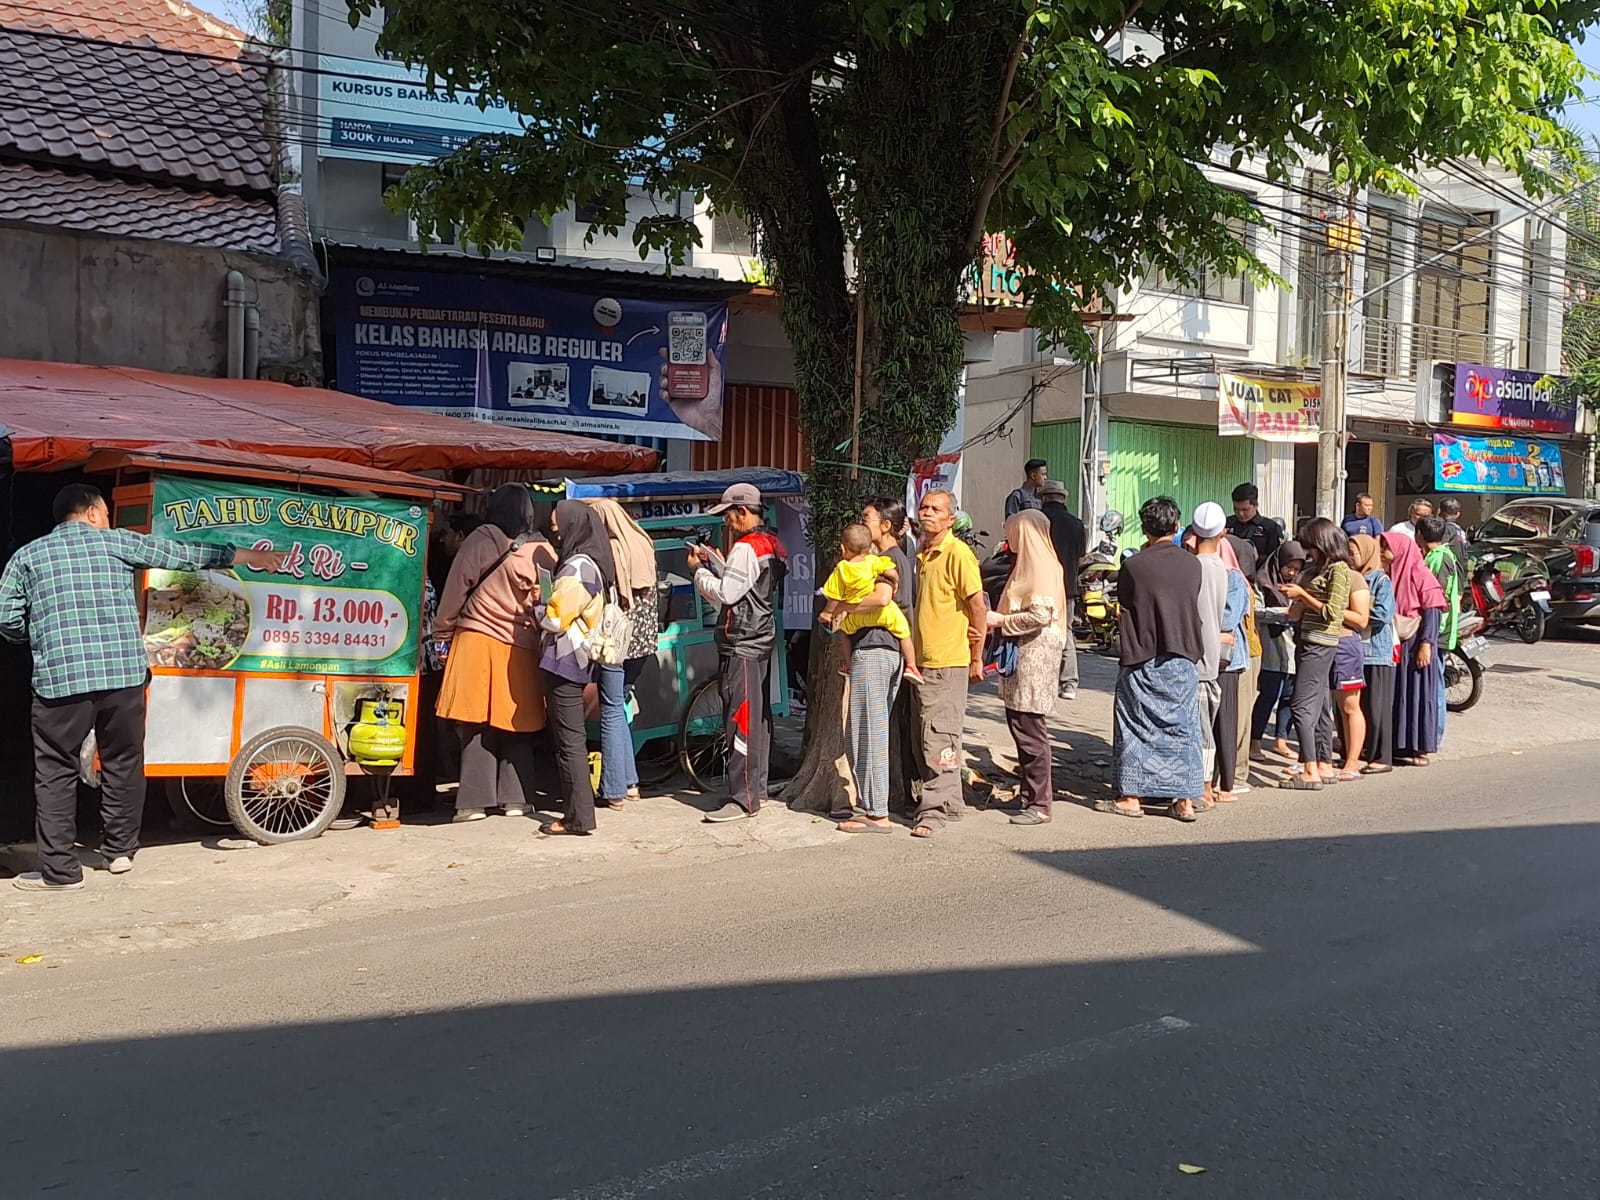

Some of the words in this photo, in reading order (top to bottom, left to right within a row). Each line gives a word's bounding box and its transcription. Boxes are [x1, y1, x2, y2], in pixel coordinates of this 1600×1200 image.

[332, 80, 393, 97] KURSUS
[397, 88, 459, 105] BAHASA
[340, 130, 374, 143] 300K
[383, 135, 414, 145] BULAN
[360, 305, 409, 319] MEMBUKA
[410, 308, 478, 323] PENDAFTARAN
[478, 311, 518, 327] PESERTA
[519, 315, 545, 329] BARU
[355, 322, 415, 346] KELAS
[418, 325, 489, 351] BAHASA
[492, 331, 541, 356] ARAB
[545, 336, 623, 363] REGULER
[1227, 381, 1265, 403] JUAL
[1269, 387, 1292, 404] CAT
[641, 501, 693, 518] Bakso
[164, 496, 272, 533] TAHU
[278, 498, 419, 557] CAMPUR
[309, 544, 345, 580] Ri
[266, 594, 304, 624] Rp.
[312, 597, 399, 628] 13.000,-
[262, 629, 300, 644] 0895
[304, 631, 340, 646] 3394
[343, 633, 386, 648] 84431
[260, 660, 287, 670] #Asli
[289, 660, 340, 671] Lamongan
